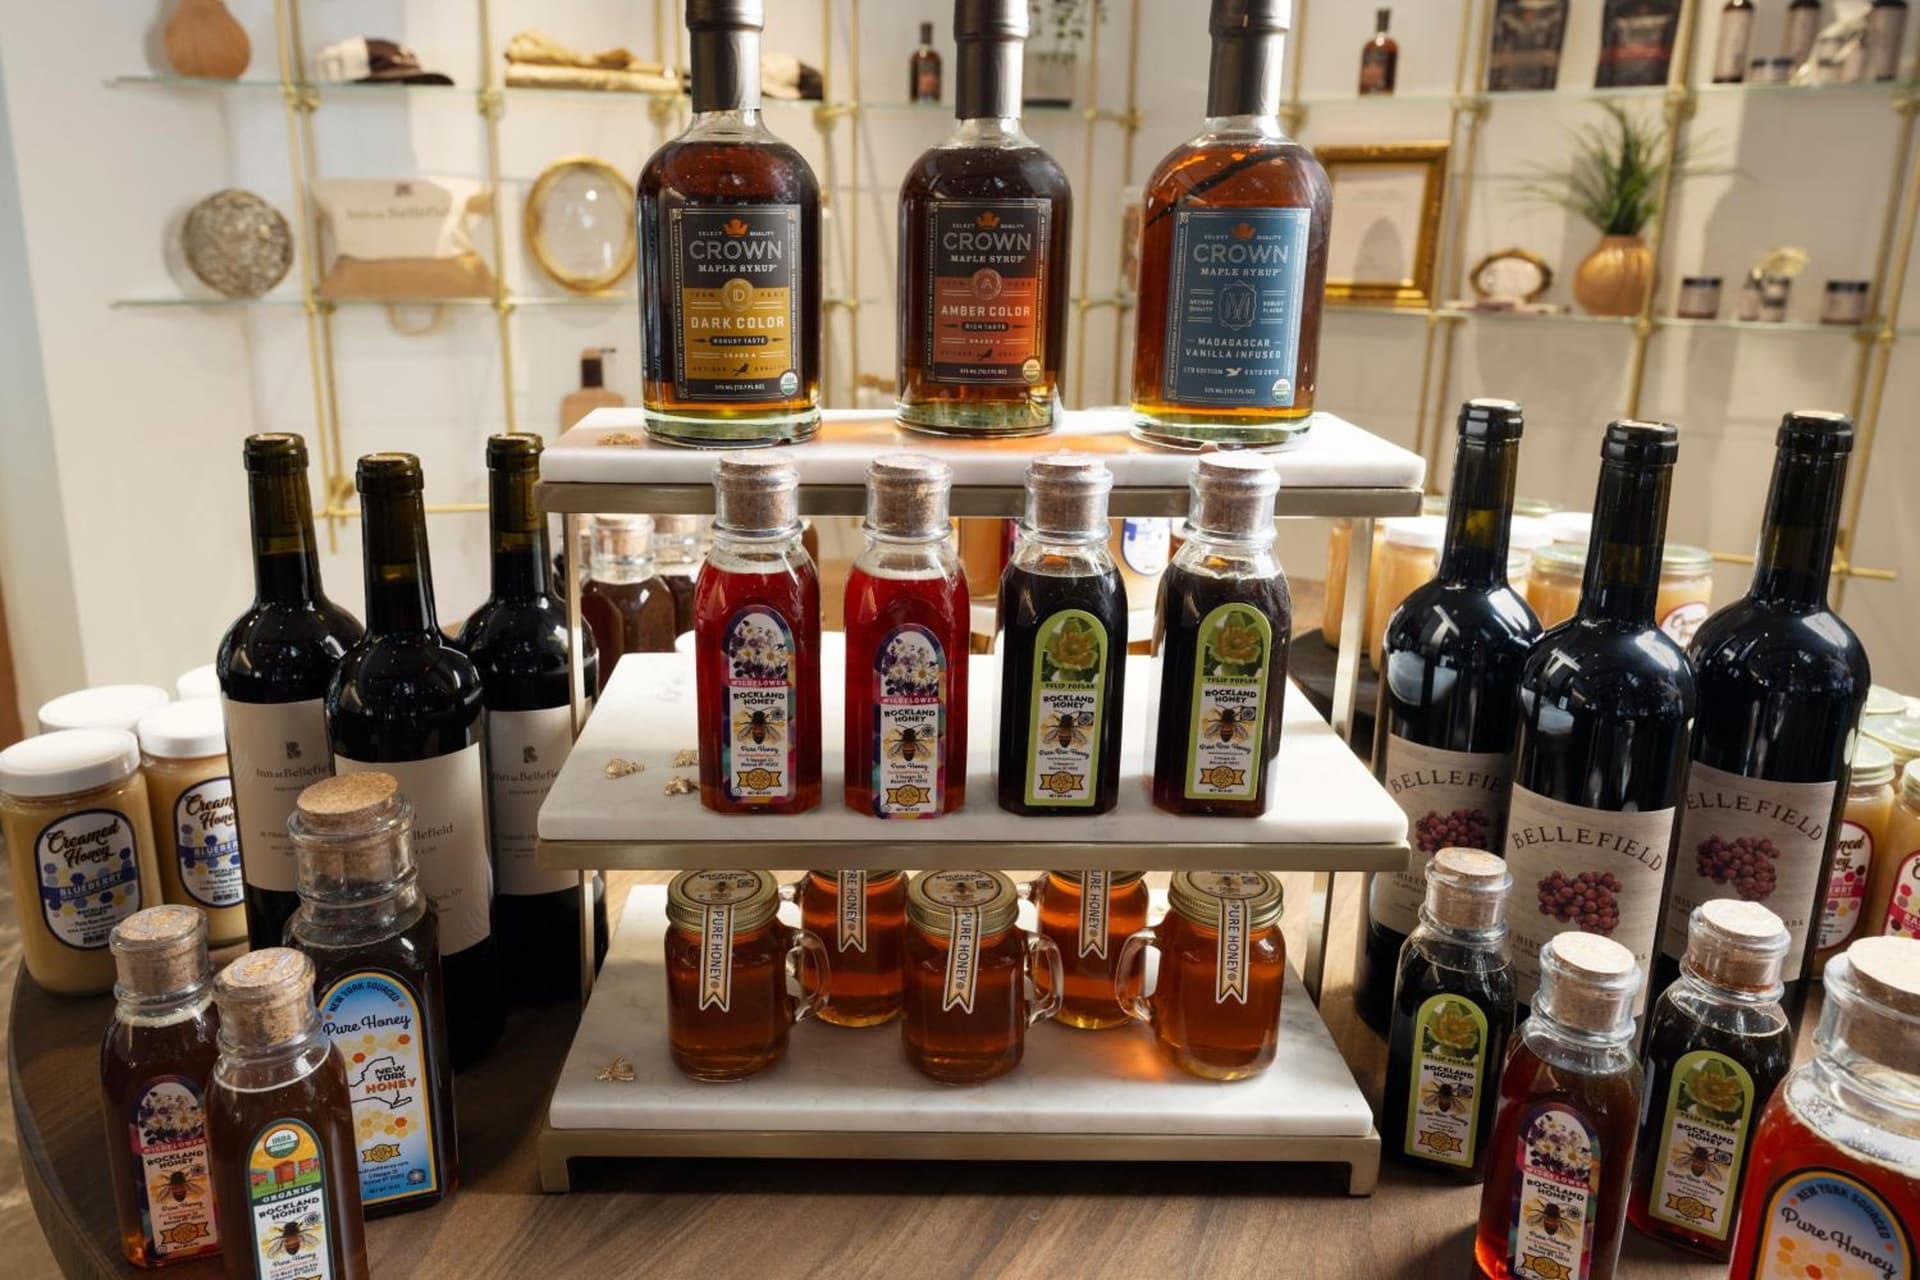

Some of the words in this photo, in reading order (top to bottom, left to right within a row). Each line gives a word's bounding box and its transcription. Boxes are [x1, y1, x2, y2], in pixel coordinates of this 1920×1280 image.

[688, 240, 782, 260] CROWN
[943, 232, 1032, 251] CROWN
[950, 254, 986, 263] MAPLE
[1193, 244, 1288, 264] CROWN
[698, 264, 736, 272] MAPLE
[1200, 268, 1239, 276] MAPLE
[940, 306, 986, 317] AMBER
[989, 306, 1031, 317] COLOR
[691, 317, 732, 329] DARK
[736, 316, 784, 329] COLOR
[1198, 338, 1270, 347] MADAGASCAR
[1185, 348, 1232, 359] VANILLA
[1236, 350, 1281, 359] INFUSED
[734, 692, 785, 700] ROCKLAND
[1044, 696, 1094, 704] ROCKLAND
[1205, 690, 1257, 698] ROCKLAND
[884, 710, 936, 718] ROCKLAND
[1390, 770, 1500, 794] BELLEFIE
[186, 794, 234, 816] Cream
[200, 808, 235, 830] Hone
[1686, 792, 1824, 842] ELLEFIELD
[46, 818, 120, 854] Creamed
[413, 822, 453, 840] llefield
[64, 846, 115, 868] Honey
[1512, 826, 1663, 872] BELLEFIELD
[60, 872, 122, 897] BLUEBERRY
[1090, 870, 1102, 891] URE
[847, 892, 858, 922] HONEY
[1088, 894, 1100, 930] HONEY
[712, 910, 724, 942] PURE
[960, 912, 973, 943] PURE
[1228, 904, 1240, 936] PURE
[710, 945, 722, 982] HONEY
[956, 946, 970, 983] HONEY
[1226, 939, 1239, 974] HONEY
[328, 990, 346, 1014] NEW
[342, 981, 365, 1000] YORK
[366, 981, 400, 1002] SOURCED
[322, 1021, 362, 1036] Pure
[361, 1013, 412, 1030] Honey
[374, 1064, 406, 1076] NEW
[376, 1072, 406, 1082] YORK
[1424, 1065, 1474, 1080] ROCKLAND
[1433, 1071, 1464, 1082] HONEY
[366, 1078, 417, 1094] HONEY
[1676, 1123, 1734, 1147] ROCKLAND
[1687, 1132, 1722, 1148] HONEY
[146, 1150, 204, 1166] ROCKLAND
[159, 1158, 194, 1169] HONEY
[262, 1184, 313, 1203] ORGANIC
[1526, 1180, 1585, 1202] ROCKLAND
[1537, 1188, 1573, 1203] HONEY
[258, 1196, 320, 1218] ROCKLAND
[272, 1205, 310, 1221] HONEY
[1796, 1184, 1819, 1202] NEW
[1820, 1184, 1848, 1198] YORK
[1852, 1193, 1891, 1240] SOURCED
[1781, 1206, 1829, 1242] Pure
[1830, 1230, 1898, 1280] Honey
